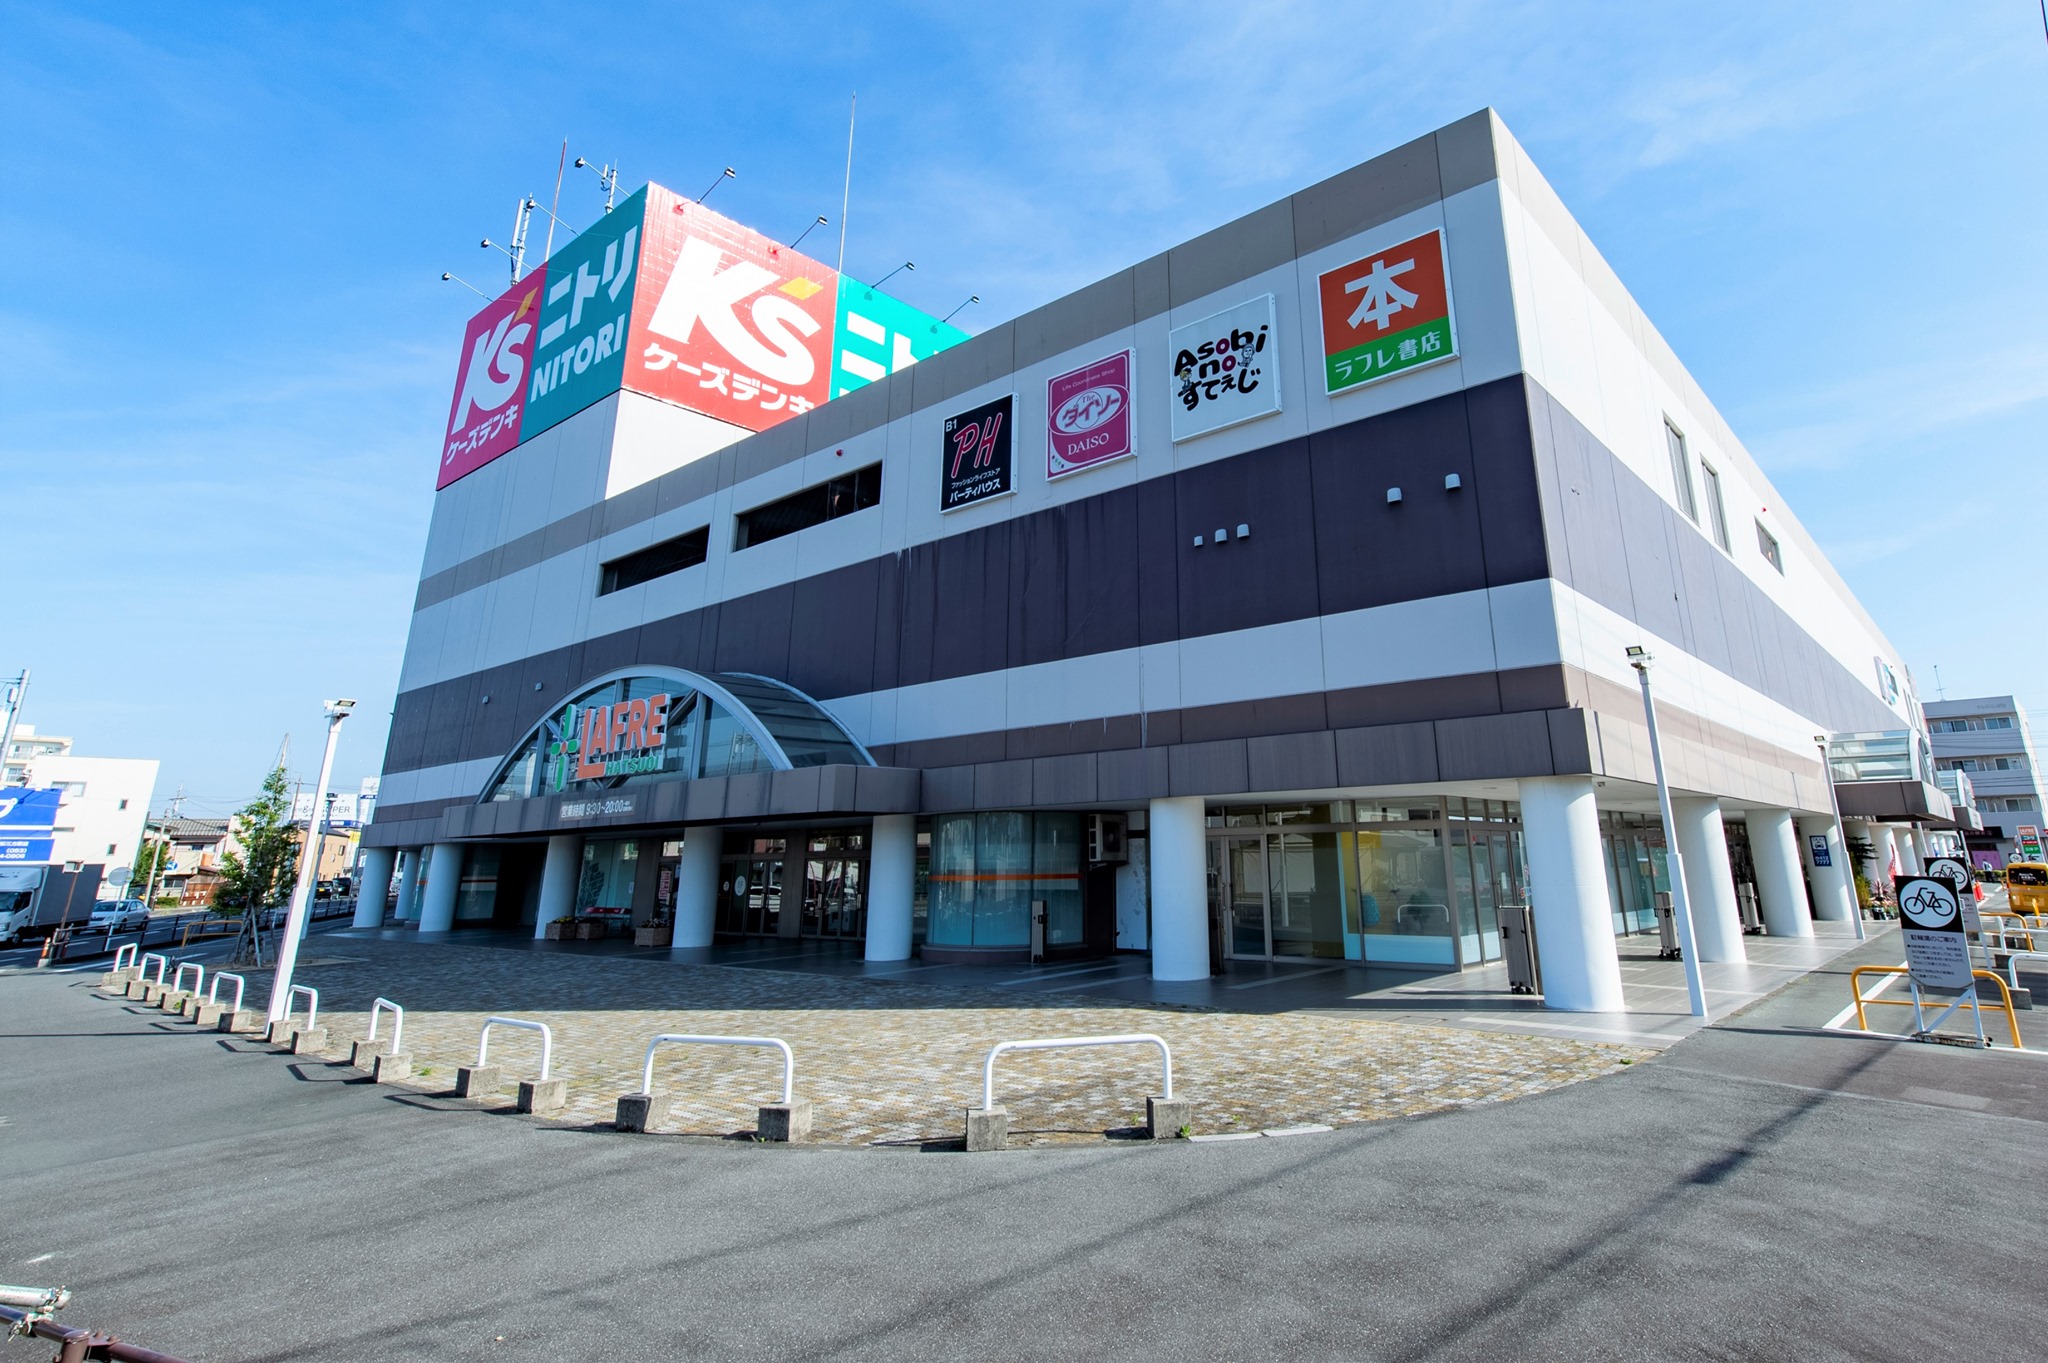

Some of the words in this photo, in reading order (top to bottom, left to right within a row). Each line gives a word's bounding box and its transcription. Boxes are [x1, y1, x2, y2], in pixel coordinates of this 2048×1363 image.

[539, 225, 638, 350] ニトリ
[1344, 257, 1419, 331] 本
[530, 312, 626, 404] NITORI
[1174, 324, 1269, 377] Asobi
[1198, 354, 1236, 379] no
[1334, 330, 1441, 381] ラフレ書店
[445, 403, 519, 466] ケーズデンキ
[945, 419, 957, 433] B1
[1062, 393, 1120, 428] ダイソー
[951, 412, 1003, 479] PH
[1067, 432, 1110, 456] DAISO
[576, 693, 670, 779] LAFRE
